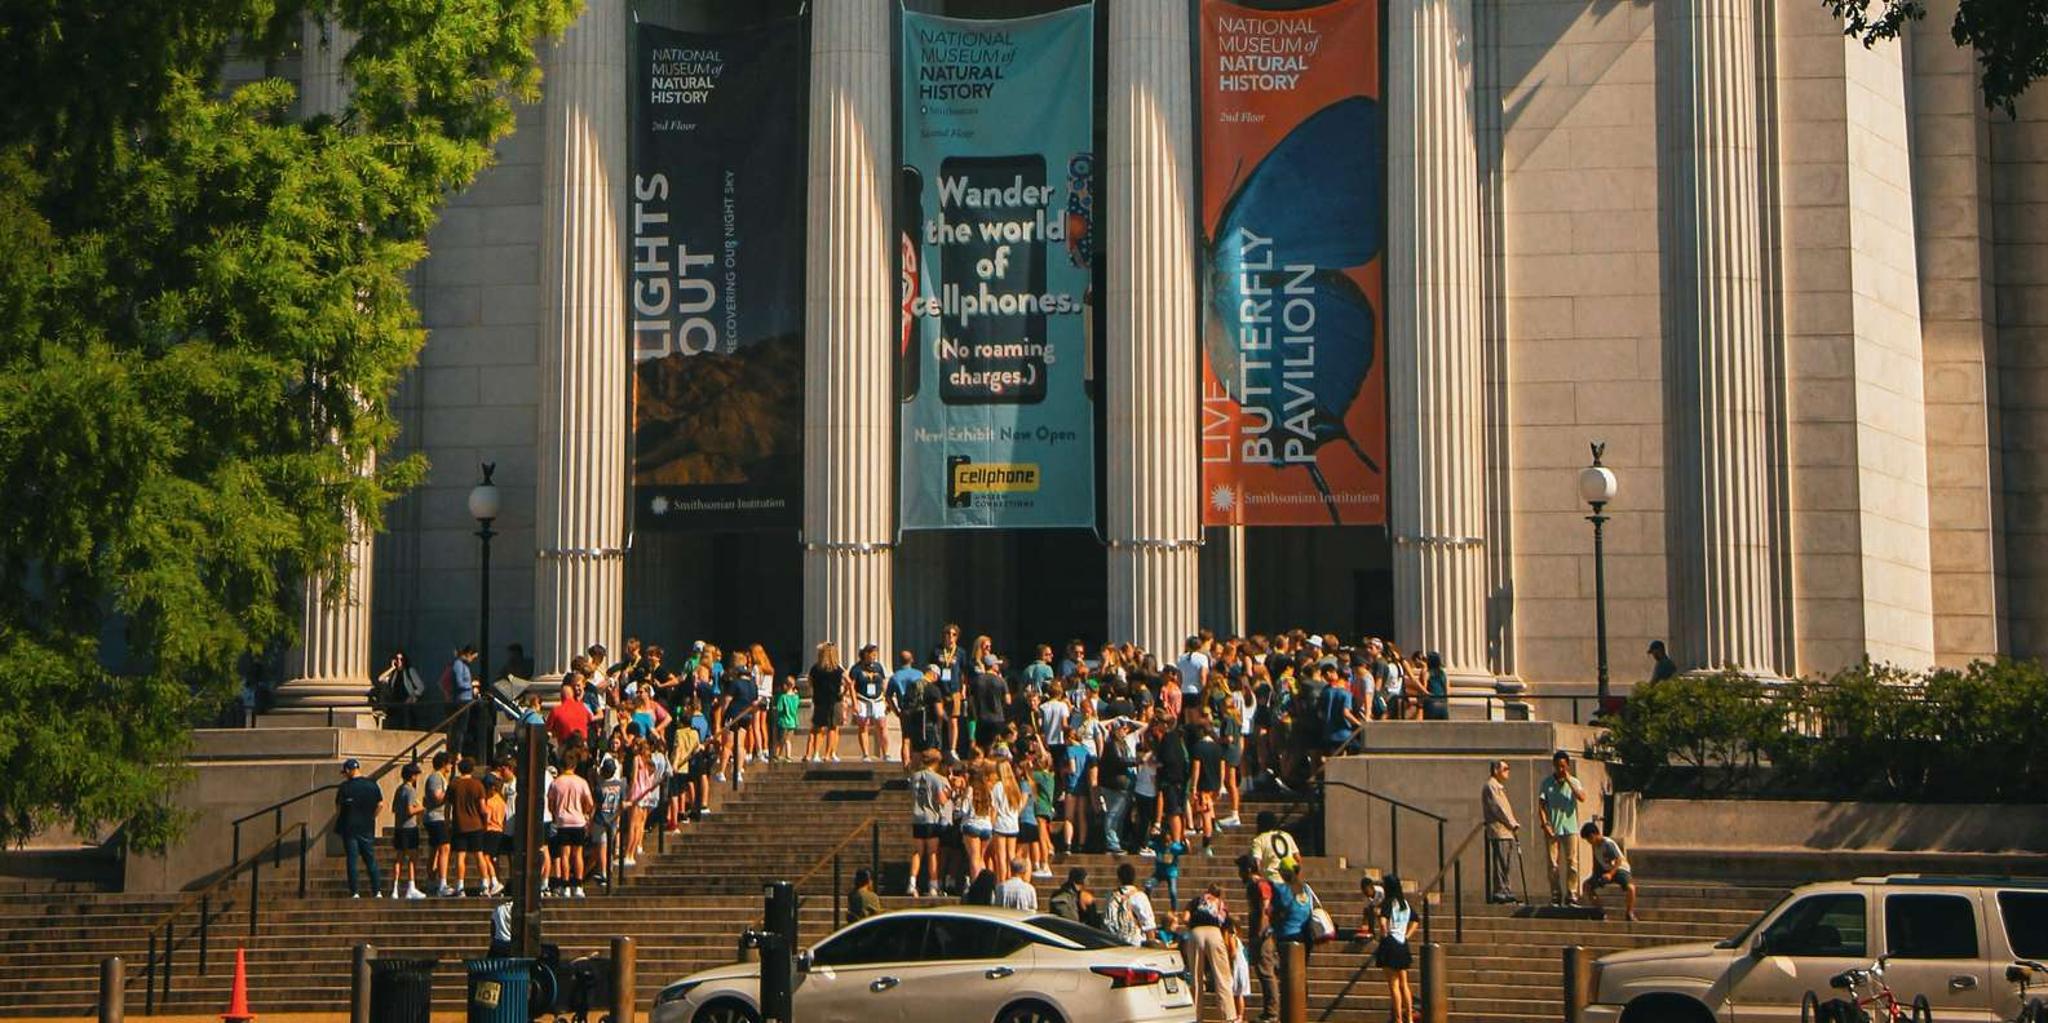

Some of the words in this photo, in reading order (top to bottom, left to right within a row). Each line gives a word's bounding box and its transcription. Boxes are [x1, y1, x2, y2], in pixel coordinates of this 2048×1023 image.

[1219, 17, 1317, 35] NATIONAL
[920, 29, 1014, 46] NATIONAL
[1219, 36, 1301, 53] MUSEUM
[1304, 36, 1320, 57] of
[652, 49, 722, 62] NATIONAL
[920, 48, 997, 63] MUSEUM
[1001, 48, 1016, 65] of
[1220, 55, 1308, 71] NATURAL
[652, 63, 710, 76] MUSEUM
[711, 63, 724, 78] of
[920, 66, 1004, 80] NATURAL
[651, 76, 714, 90] NATURAL
[920, 83, 994, 100] HISTORY
[1219, 74, 1299, 91] HISTORY
[651, 91, 709, 104] HISTORY
[652, 121, 668, 131] 2nd
[671, 120, 697, 131] Floor
[1219, 111, 1239, 122] 2nd
[1241, 111, 1266, 123] Floor
[724, 170, 734, 194] SKY
[936, 175, 1053, 208] Wander
[724, 198, 735, 236] NIGHT
[927, 212, 972, 244] the
[979, 209, 1066, 242] world
[725, 240, 736, 268] OUR
[976, 245, 1011, 280] of
[633, 173, 671, 361] LIGHTS
[678, 244, 717, 356] OUT
[911, 282, 1082, 327] cellphones.
[725, 271, 737, 354] RECOVERING
[933, 337, 969, 361] (No
[974, 337, 1056, 364] roaming
[1240, 227, 1274, 463] BUTTERFLY
[1283, 264, 1317, 463] PAVILION
[949, 363, 1036, 393] charges.)
[1202, 380, 1231, 462] LIVE
[914, 427, 943, 443] New
[948, 426, 995, 442] Exhibit
[1036, 425, 1076, 445] Open
[959, 468, 1034, 488] cellphone
[674, 498, 735, 511] Smithsonian
[1245, 491, 1316, 504] Smithsonian
